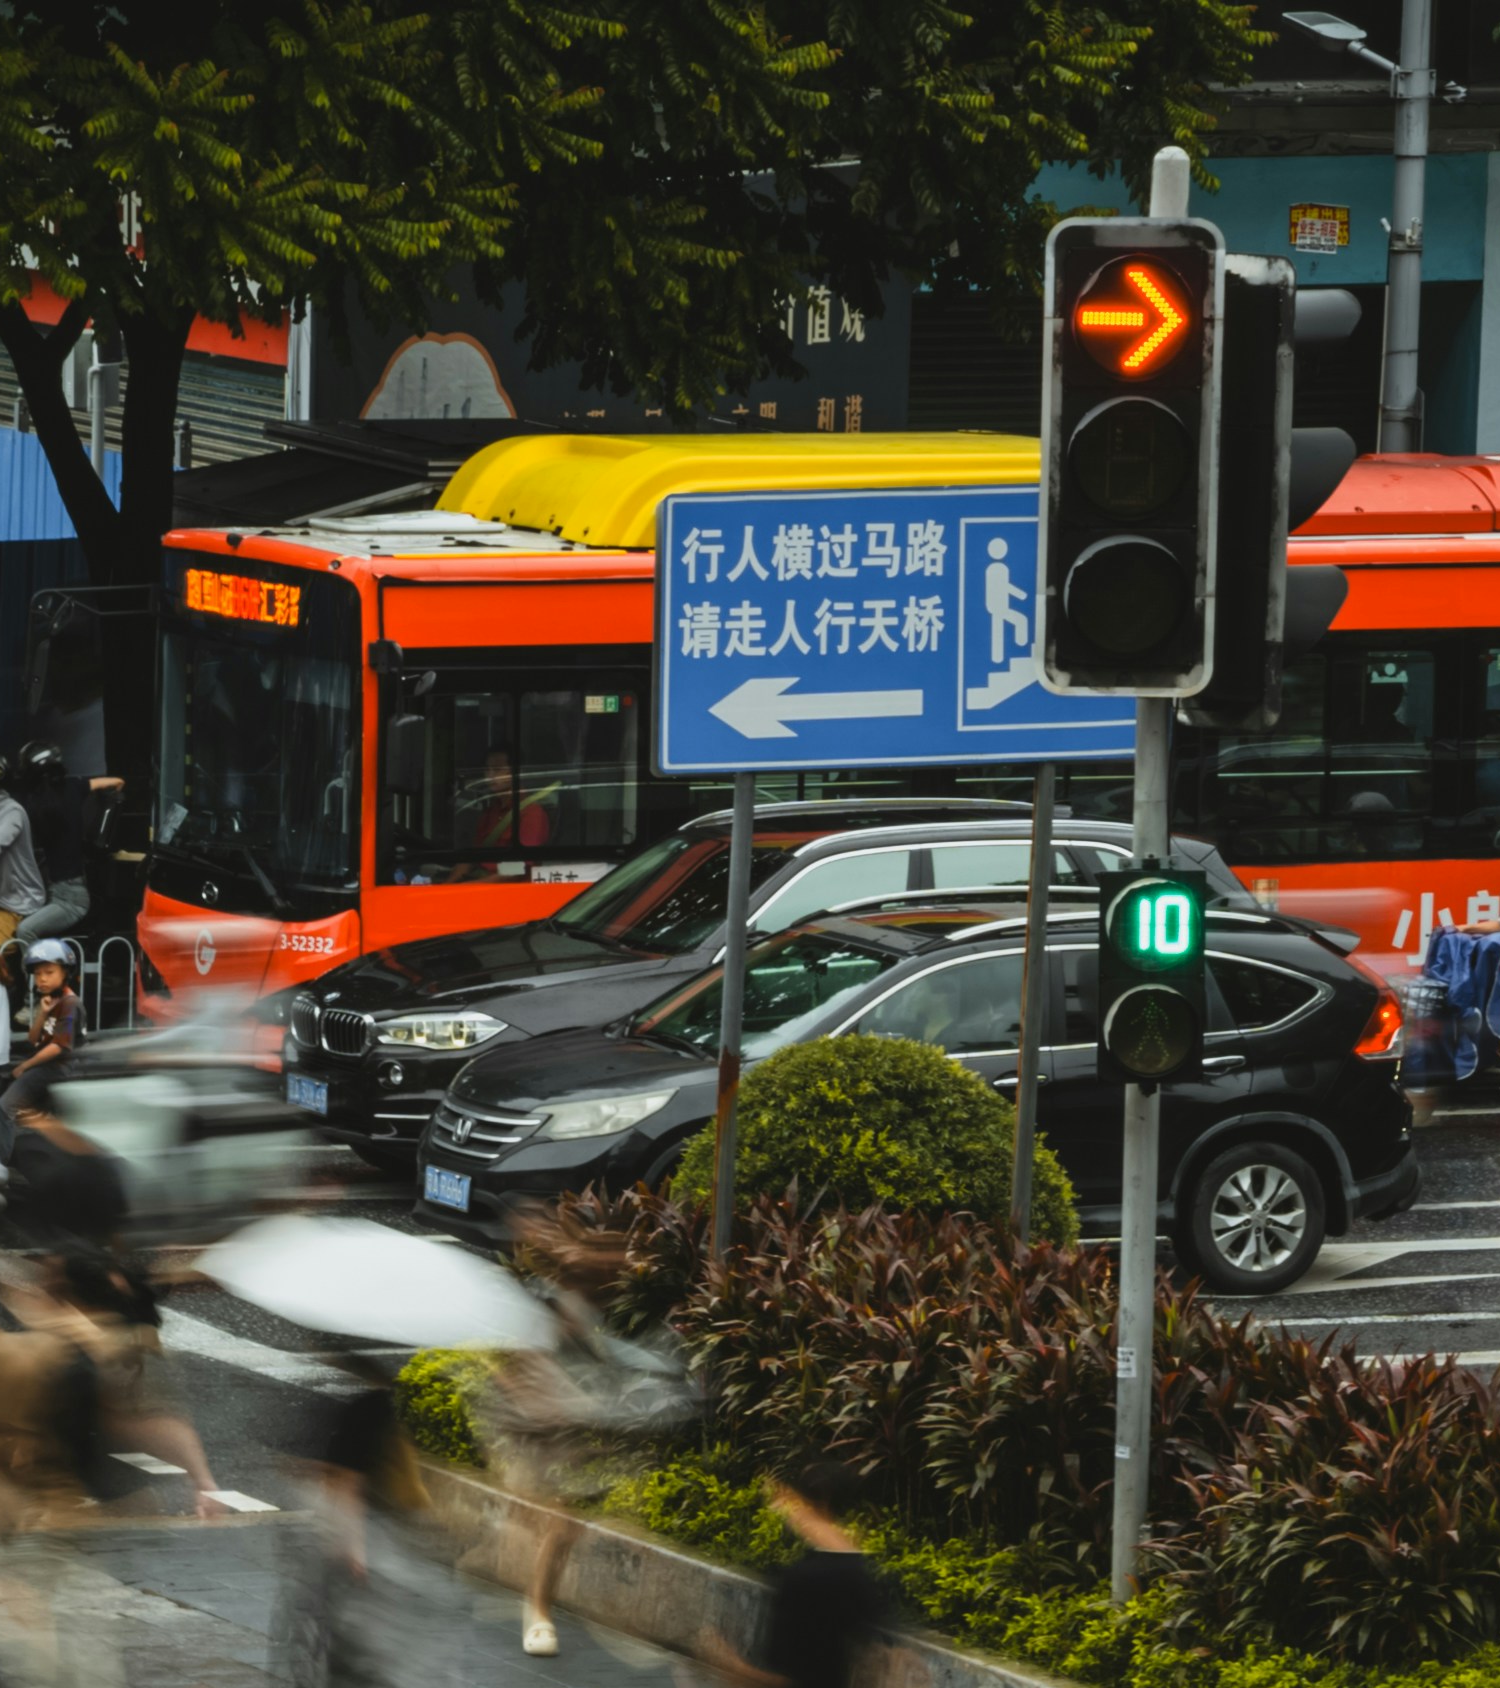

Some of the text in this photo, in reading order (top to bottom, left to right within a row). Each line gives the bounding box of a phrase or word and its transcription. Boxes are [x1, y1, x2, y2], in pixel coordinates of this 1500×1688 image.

[681, 519, 948, 584] 行人横过马路
[678, 595, 945, 659] 请走人行天桥
[280, 933, 334, 954] 3-52332
[1139, 894, 1190, 954] 10
